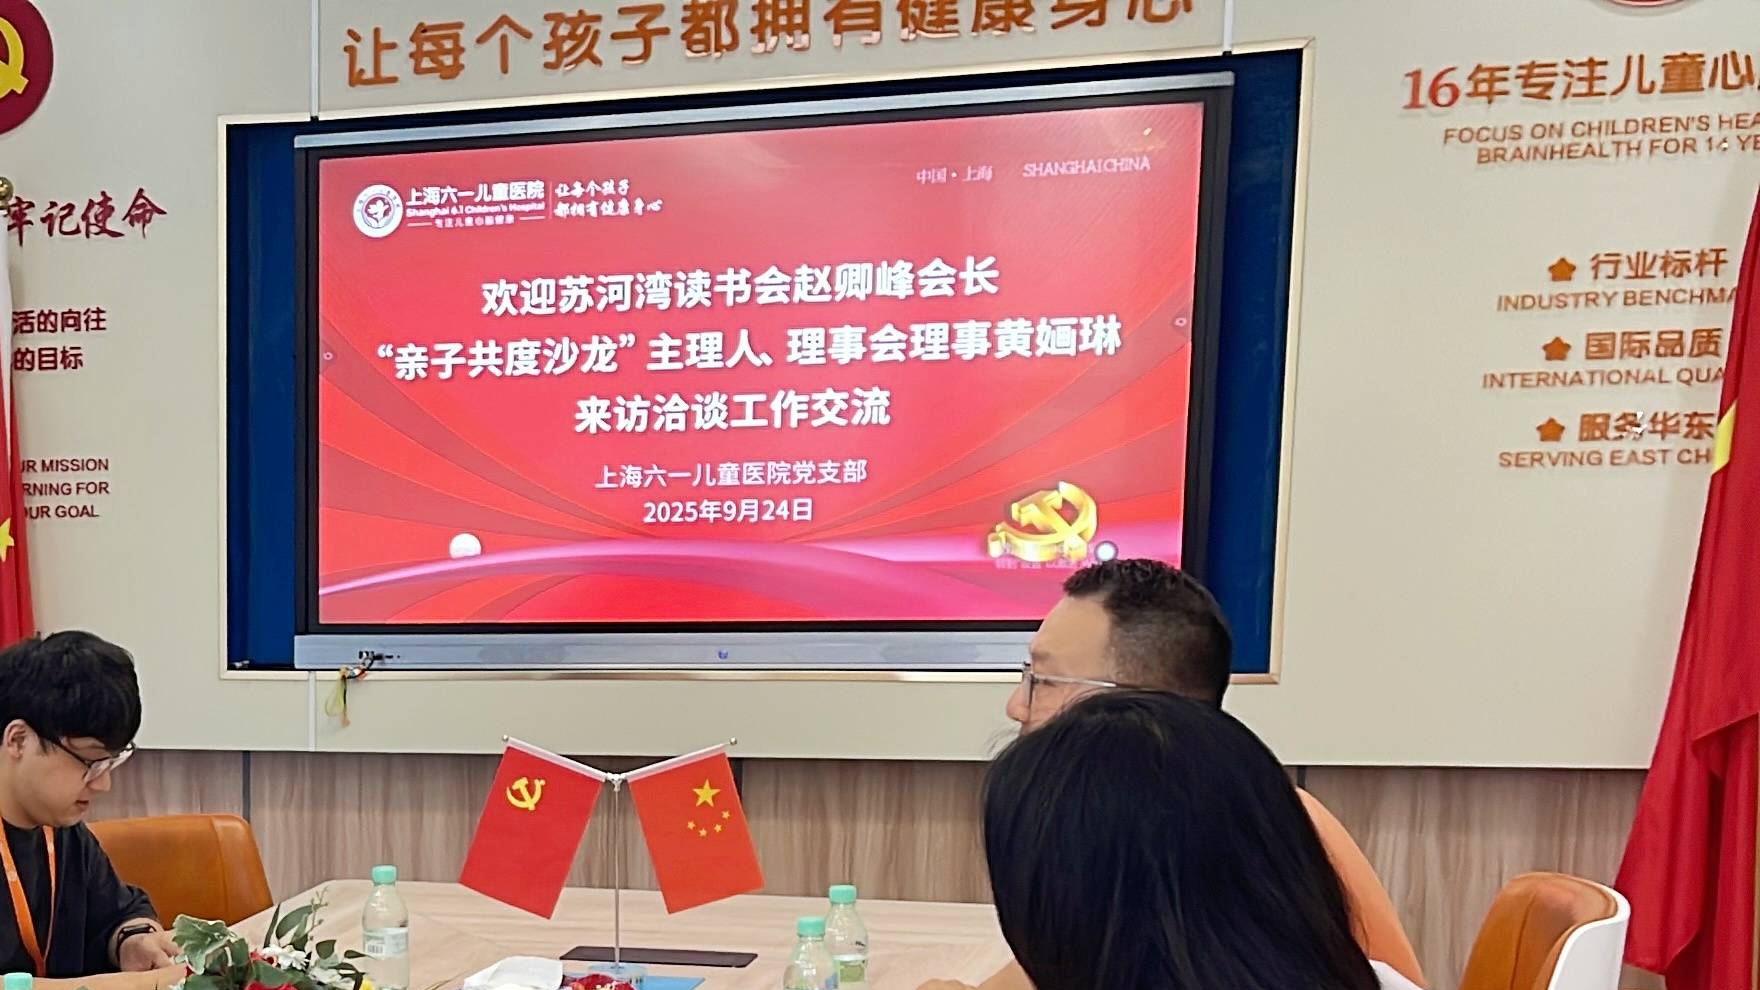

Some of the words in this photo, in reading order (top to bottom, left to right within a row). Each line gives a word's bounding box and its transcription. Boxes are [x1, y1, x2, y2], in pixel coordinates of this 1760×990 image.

[1401, 50, 1760, 110] 16年专注儿童心
[1443, 125, 1523, 145] FOCUS
[1530, 122, 1564, 140] ON
[1570, 115, 1711, 139] CHILDREN'S
[1476, 140, 1642, 165] BRAINHEALTH
[1649, 137, 1699, 156] FOR
[406, 180, 545, 206] 上海六一儿童医院
[6, 187, 168, 247] 牢记使命
[1590, 248, 1728, 281] 行业标杆
[480, 255, 1000, 317] 欢迎苏河湾读书会赵卿峰会长
[1496, 290, 1619, 312] INDUSTRY
[1585, 328, 1724, 361] 国际品质
[1482, 368, 1670, 390] INTERNATIONAL
[574, 387, 892, 434] 来访洽谈工作交流
[1579, 411, 1715, 442] 服务华东
[41, 458, 109, 473] MISSION
[1498, 449, 1603, 468] SERVING
[1609, 448, 1670, 466] EAST
[76, 481, 110, 496] FOR
[595, 459, 868, 489] 上海六一儿童医院党支部
[55, 504, 99, 519] GOAL
[643, 497, 814, 523] 2025年9月24日
